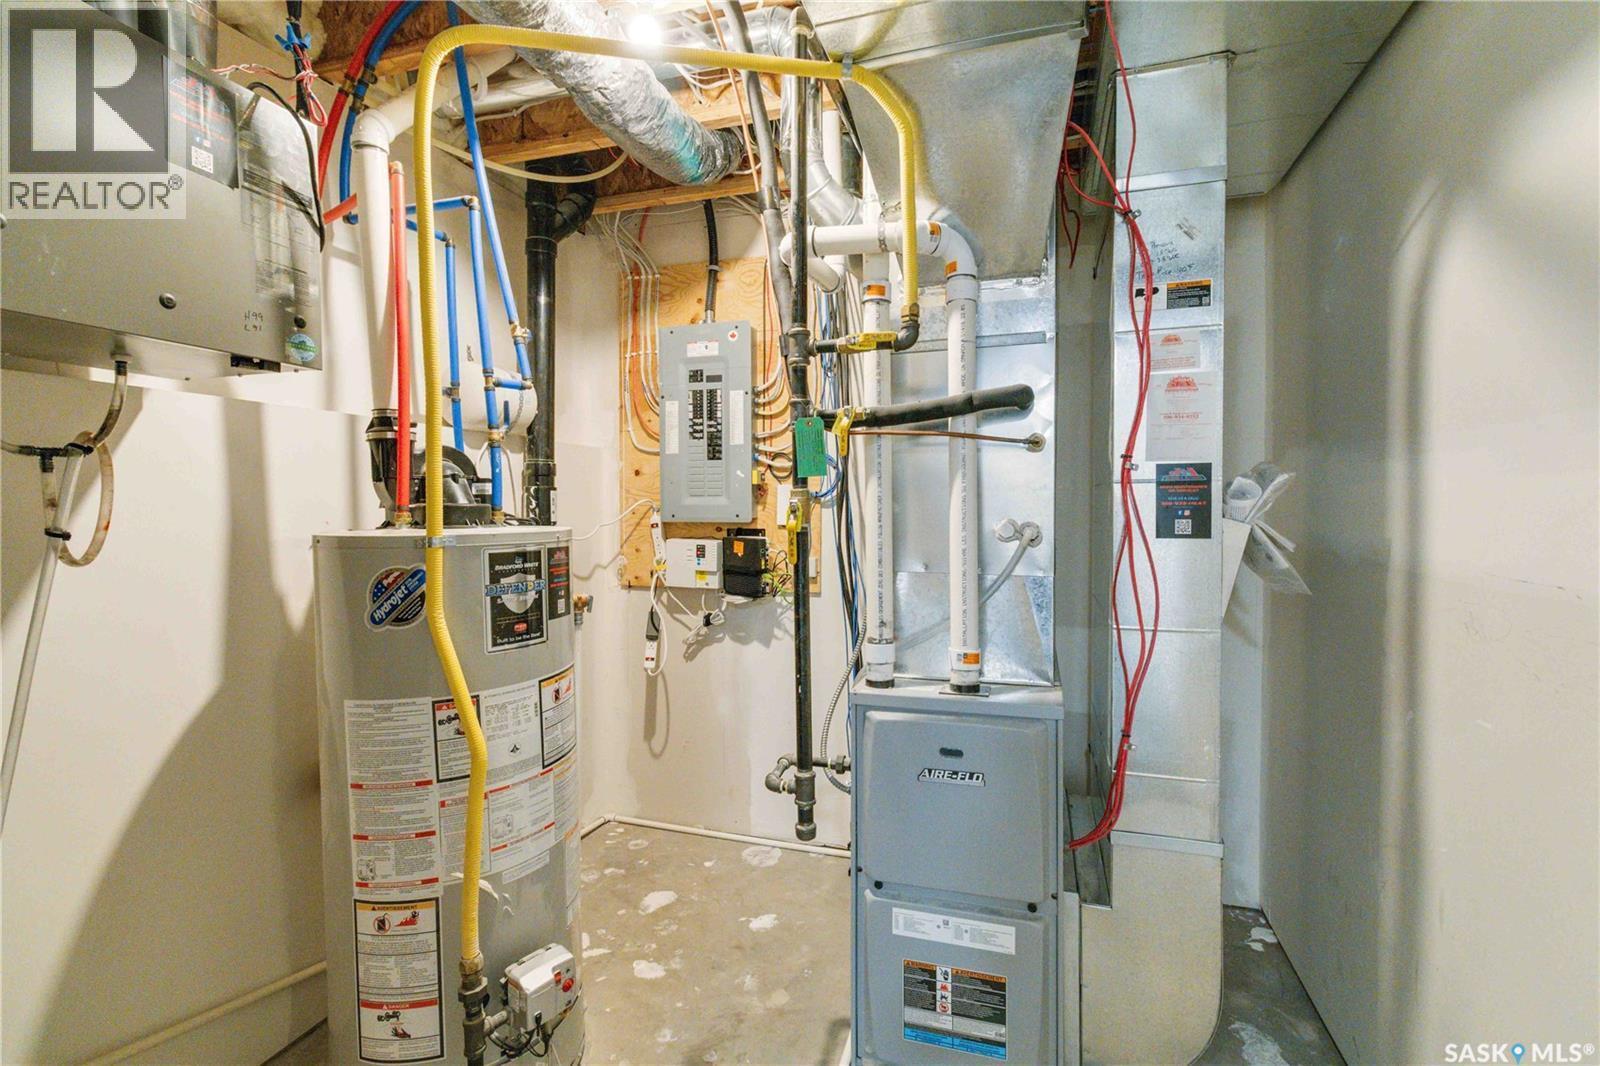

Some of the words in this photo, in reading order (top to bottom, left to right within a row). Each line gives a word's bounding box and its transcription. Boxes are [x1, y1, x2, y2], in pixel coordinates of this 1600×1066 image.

[484, 579, 546, 597] DEFENDER
[373, 584, 409, 622] Hydrojet
[920, 769, 983, 783] AIRE-FLO
